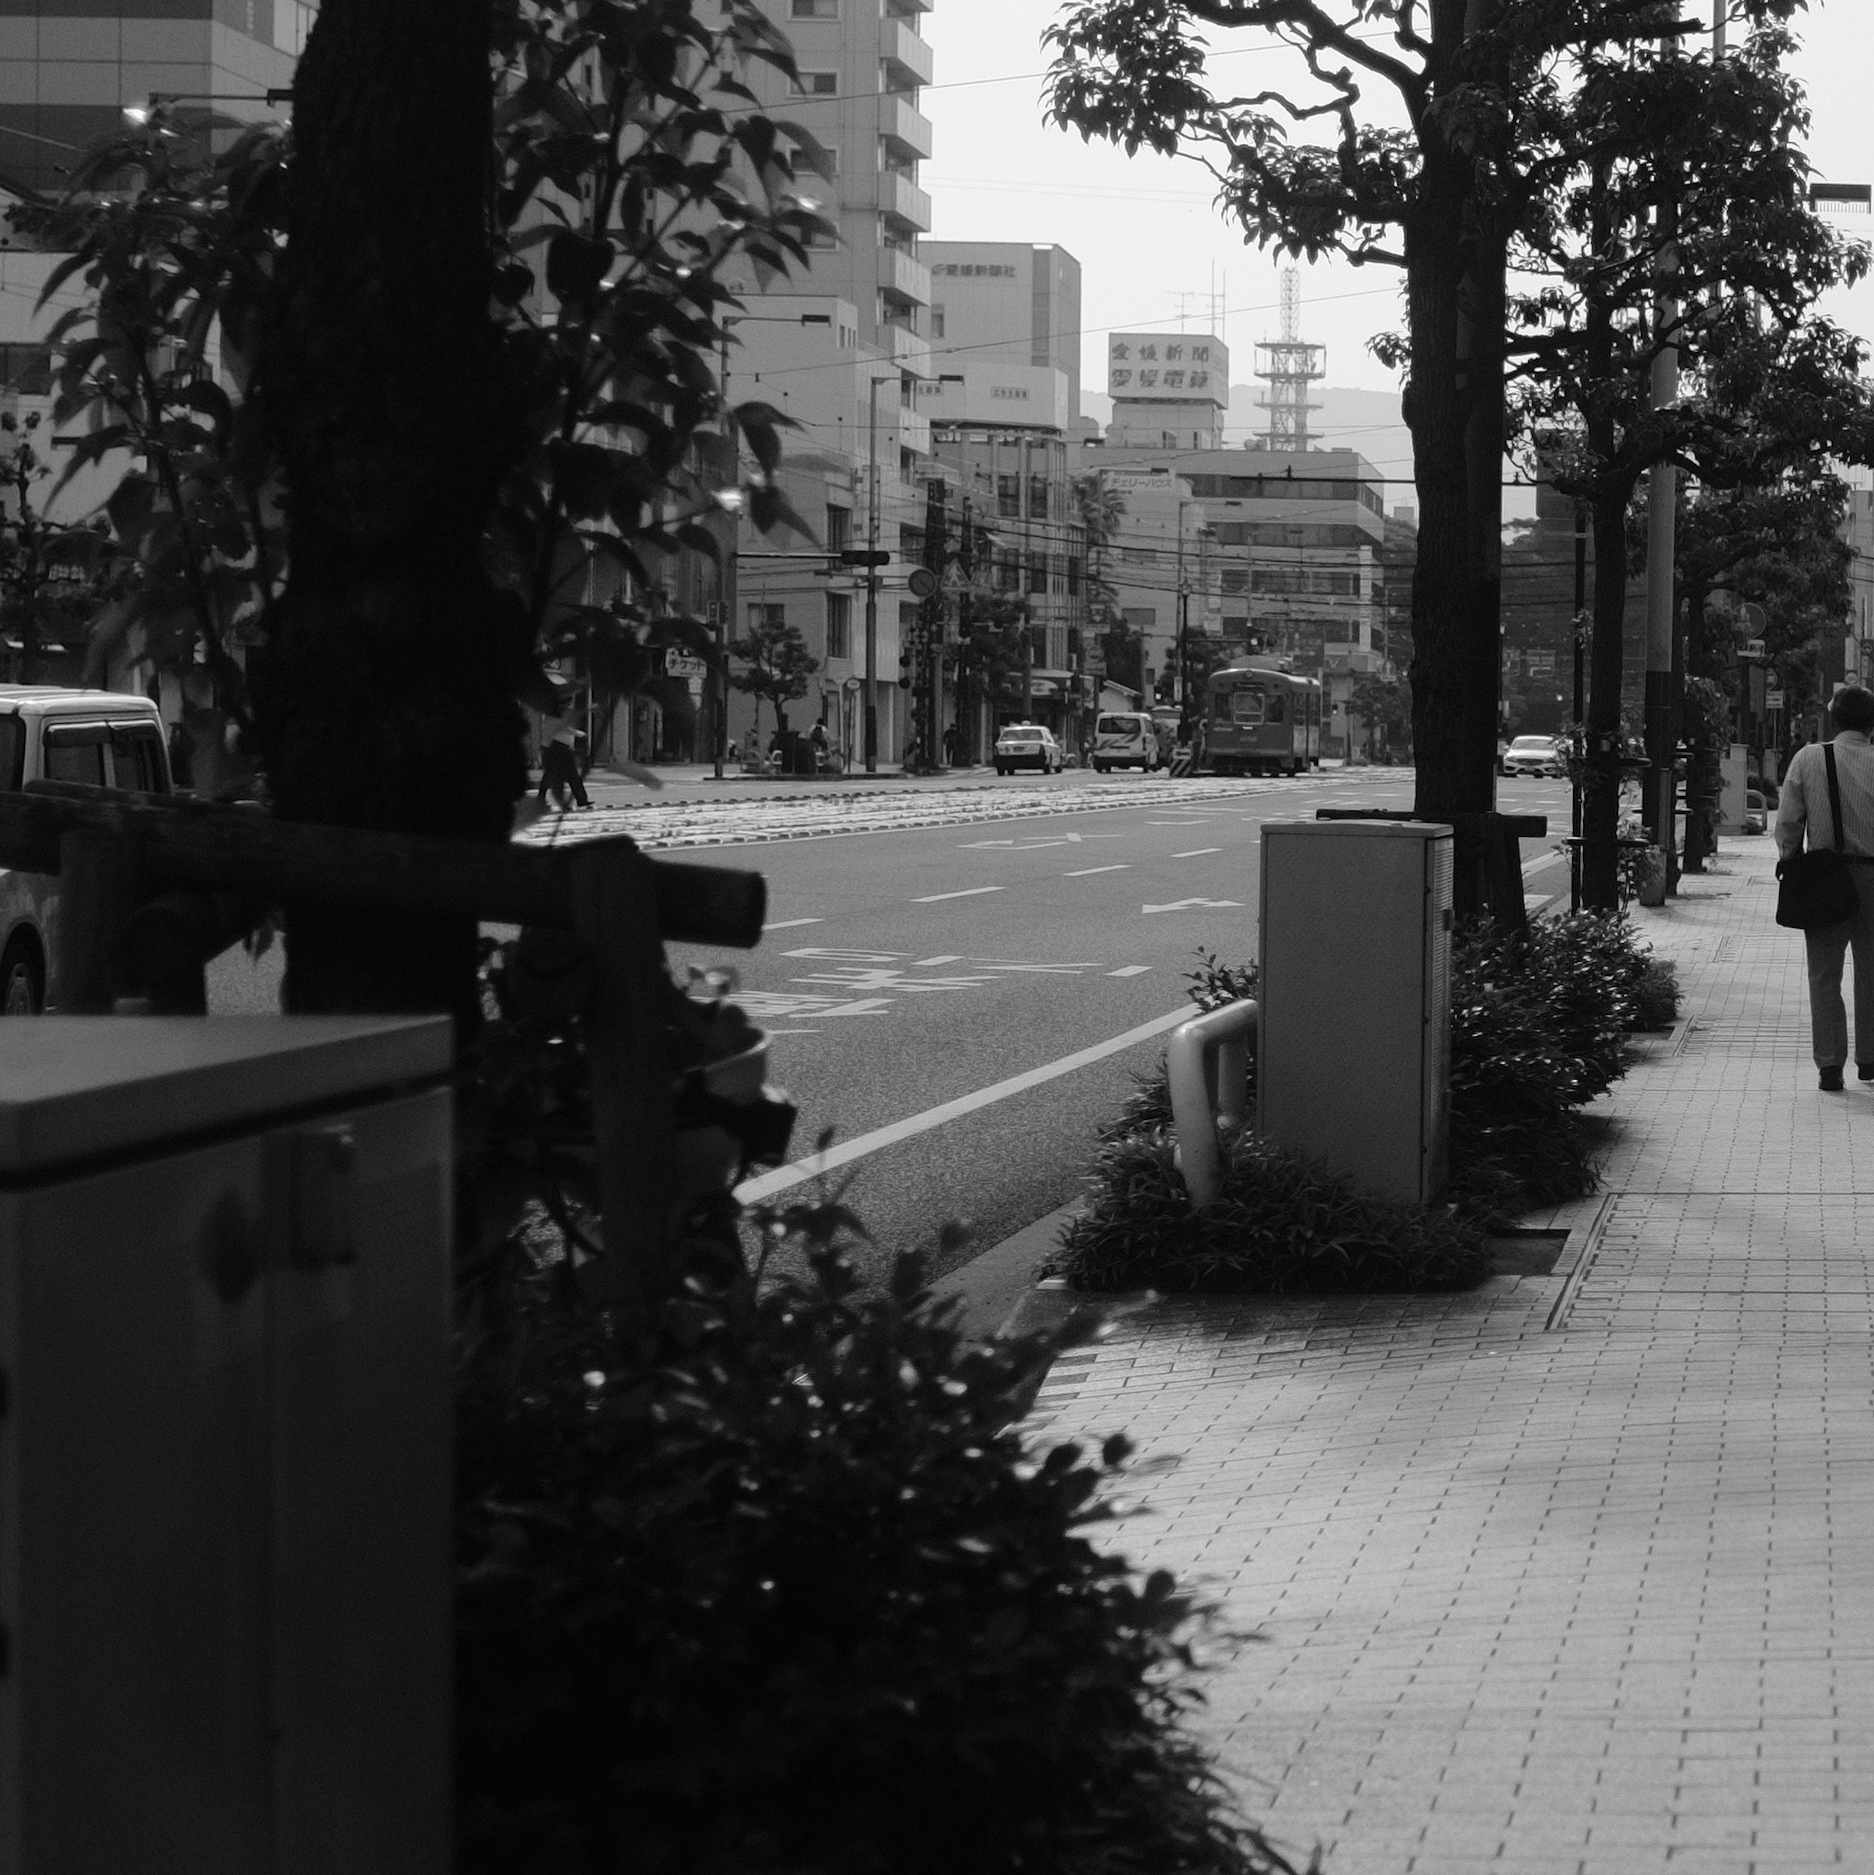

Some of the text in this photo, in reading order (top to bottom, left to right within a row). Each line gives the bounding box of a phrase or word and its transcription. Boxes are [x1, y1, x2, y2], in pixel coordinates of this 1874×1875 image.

[1111, 343, 1209, 362] 愛媛新聞
[1111, 478, 1172, 489] チェリーハウス
